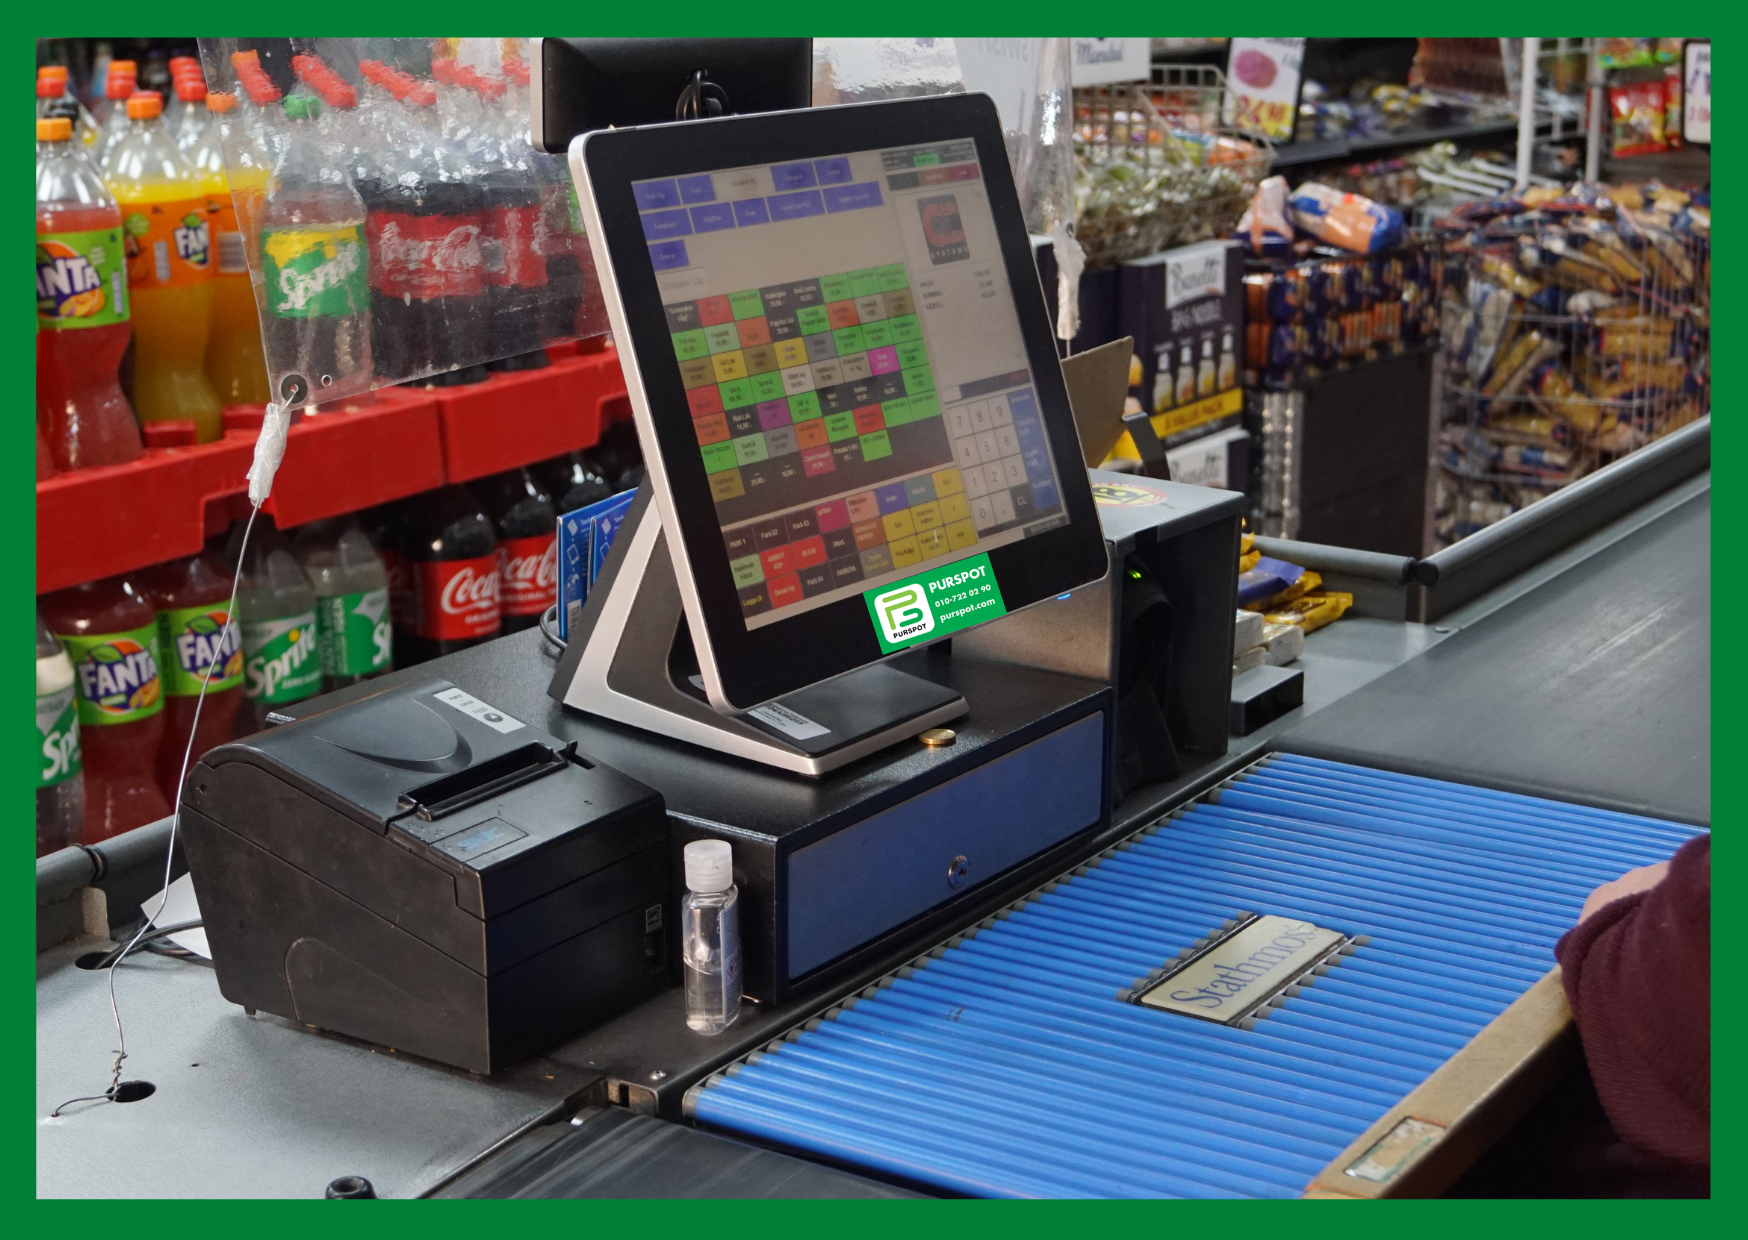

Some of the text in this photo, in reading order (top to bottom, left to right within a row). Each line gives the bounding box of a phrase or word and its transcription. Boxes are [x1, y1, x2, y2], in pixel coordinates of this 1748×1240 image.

[175, 222, 210, 258] FAN
[930, 246, 968, 259] SYSTEMS
[36, 256, 101, 298] ANTA
[997, 406, 1003, 417] 9
[956, 416, 962, 427] 7
[977, 412, 983, 423] 8
[1005, 436, 1011, 447] 6
[964, 447, 971, 458] 4
[984, 442, 990, 453] 5
[1012, 466, 1018, 477] 3
[992, 472, 998, 483] 2
[1017, 496, 1027, 506] CL
[980, 507, 986, 519] 0
[761, 531, 772, 540] Park
[801, 548, 817, 557] RETUR
[807, 578, 817, 587] Park
[175, 620, 241, 670] FANT
[246, 622, 316, 699] Sprite
[77, 648, 158, 698] FANTA
[472, 707, 488, 715] FEED
[1169, 925, 1317, 1009] Stathmos
